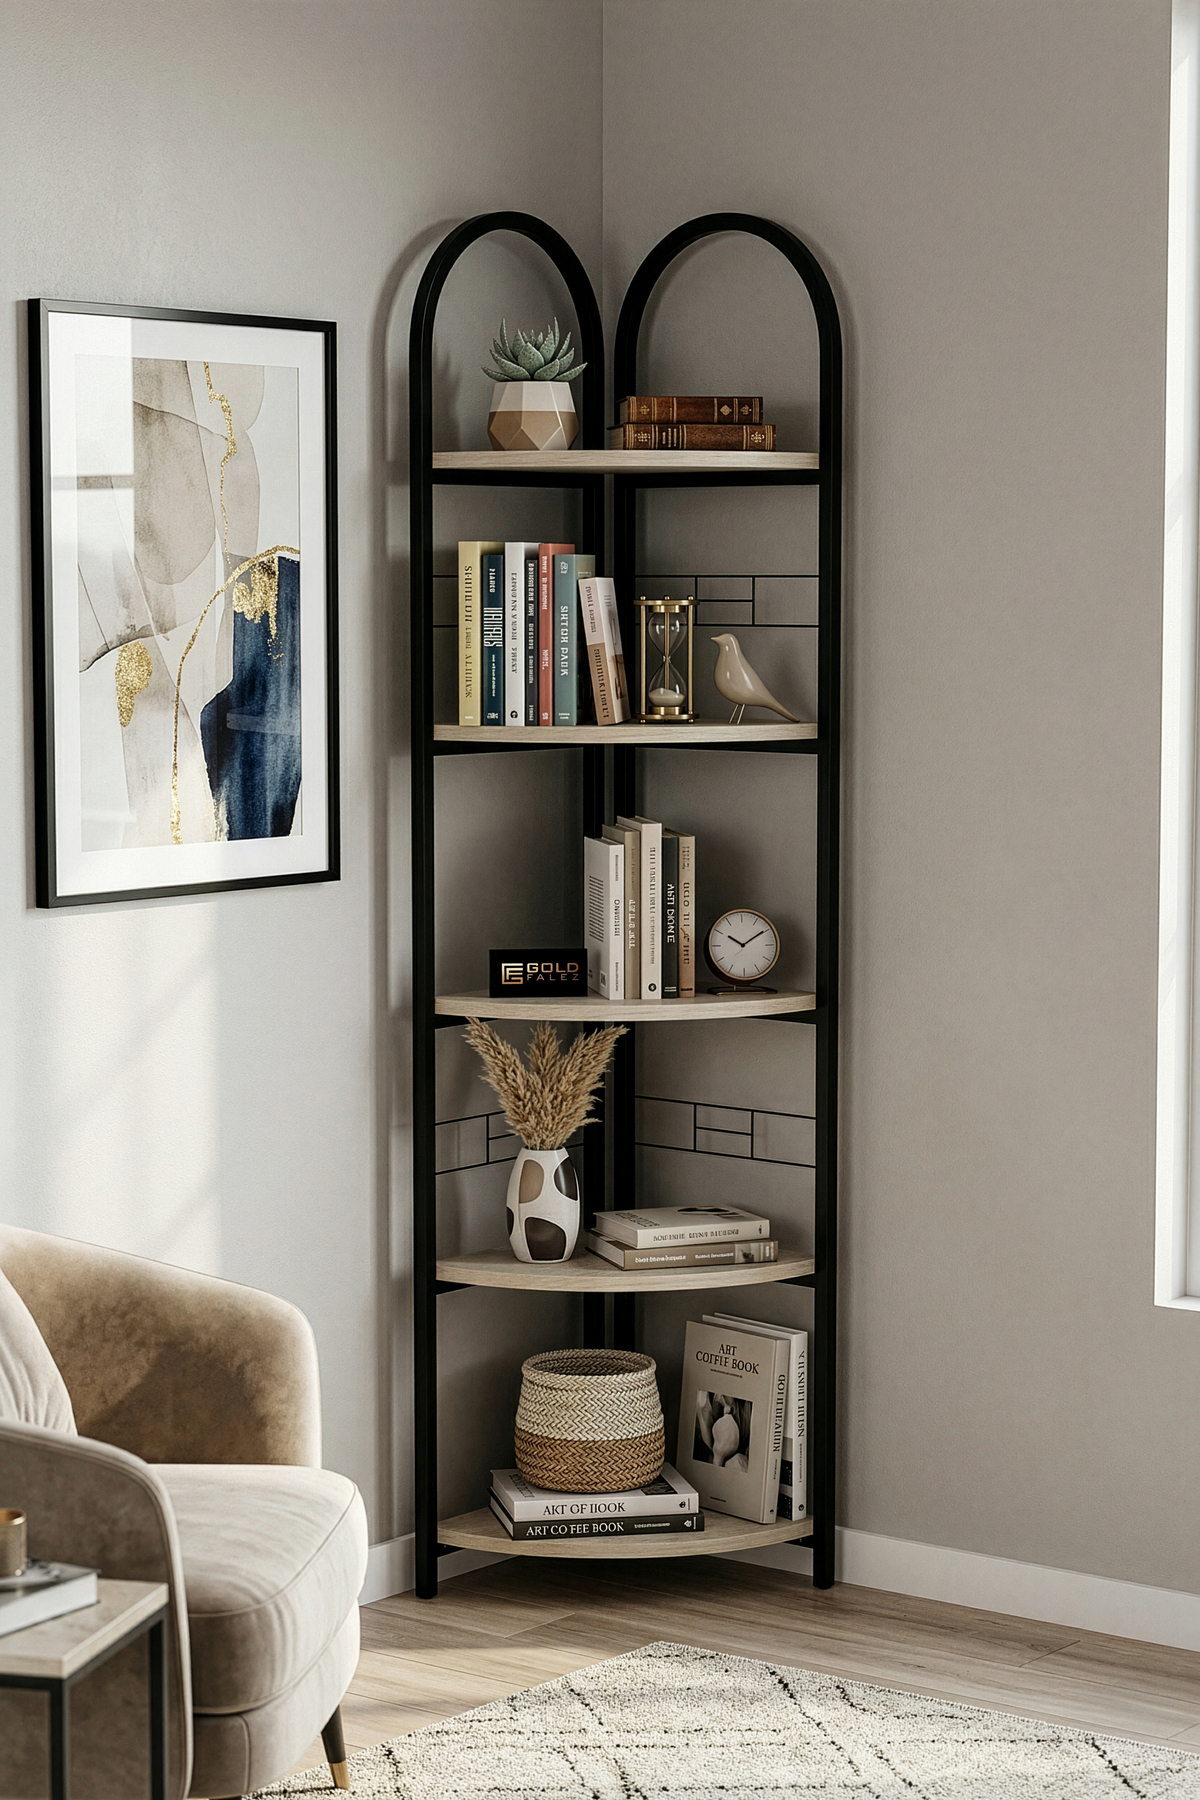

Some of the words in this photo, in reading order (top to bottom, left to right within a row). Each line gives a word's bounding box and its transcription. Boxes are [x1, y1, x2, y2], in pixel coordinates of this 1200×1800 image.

[526, 962, 579, 973] GOLD
[526, 973, 579, 981] FALEZ
[731, 1358, 760, 1375] BOOK
[526, 1525, 549, 1537] ART
